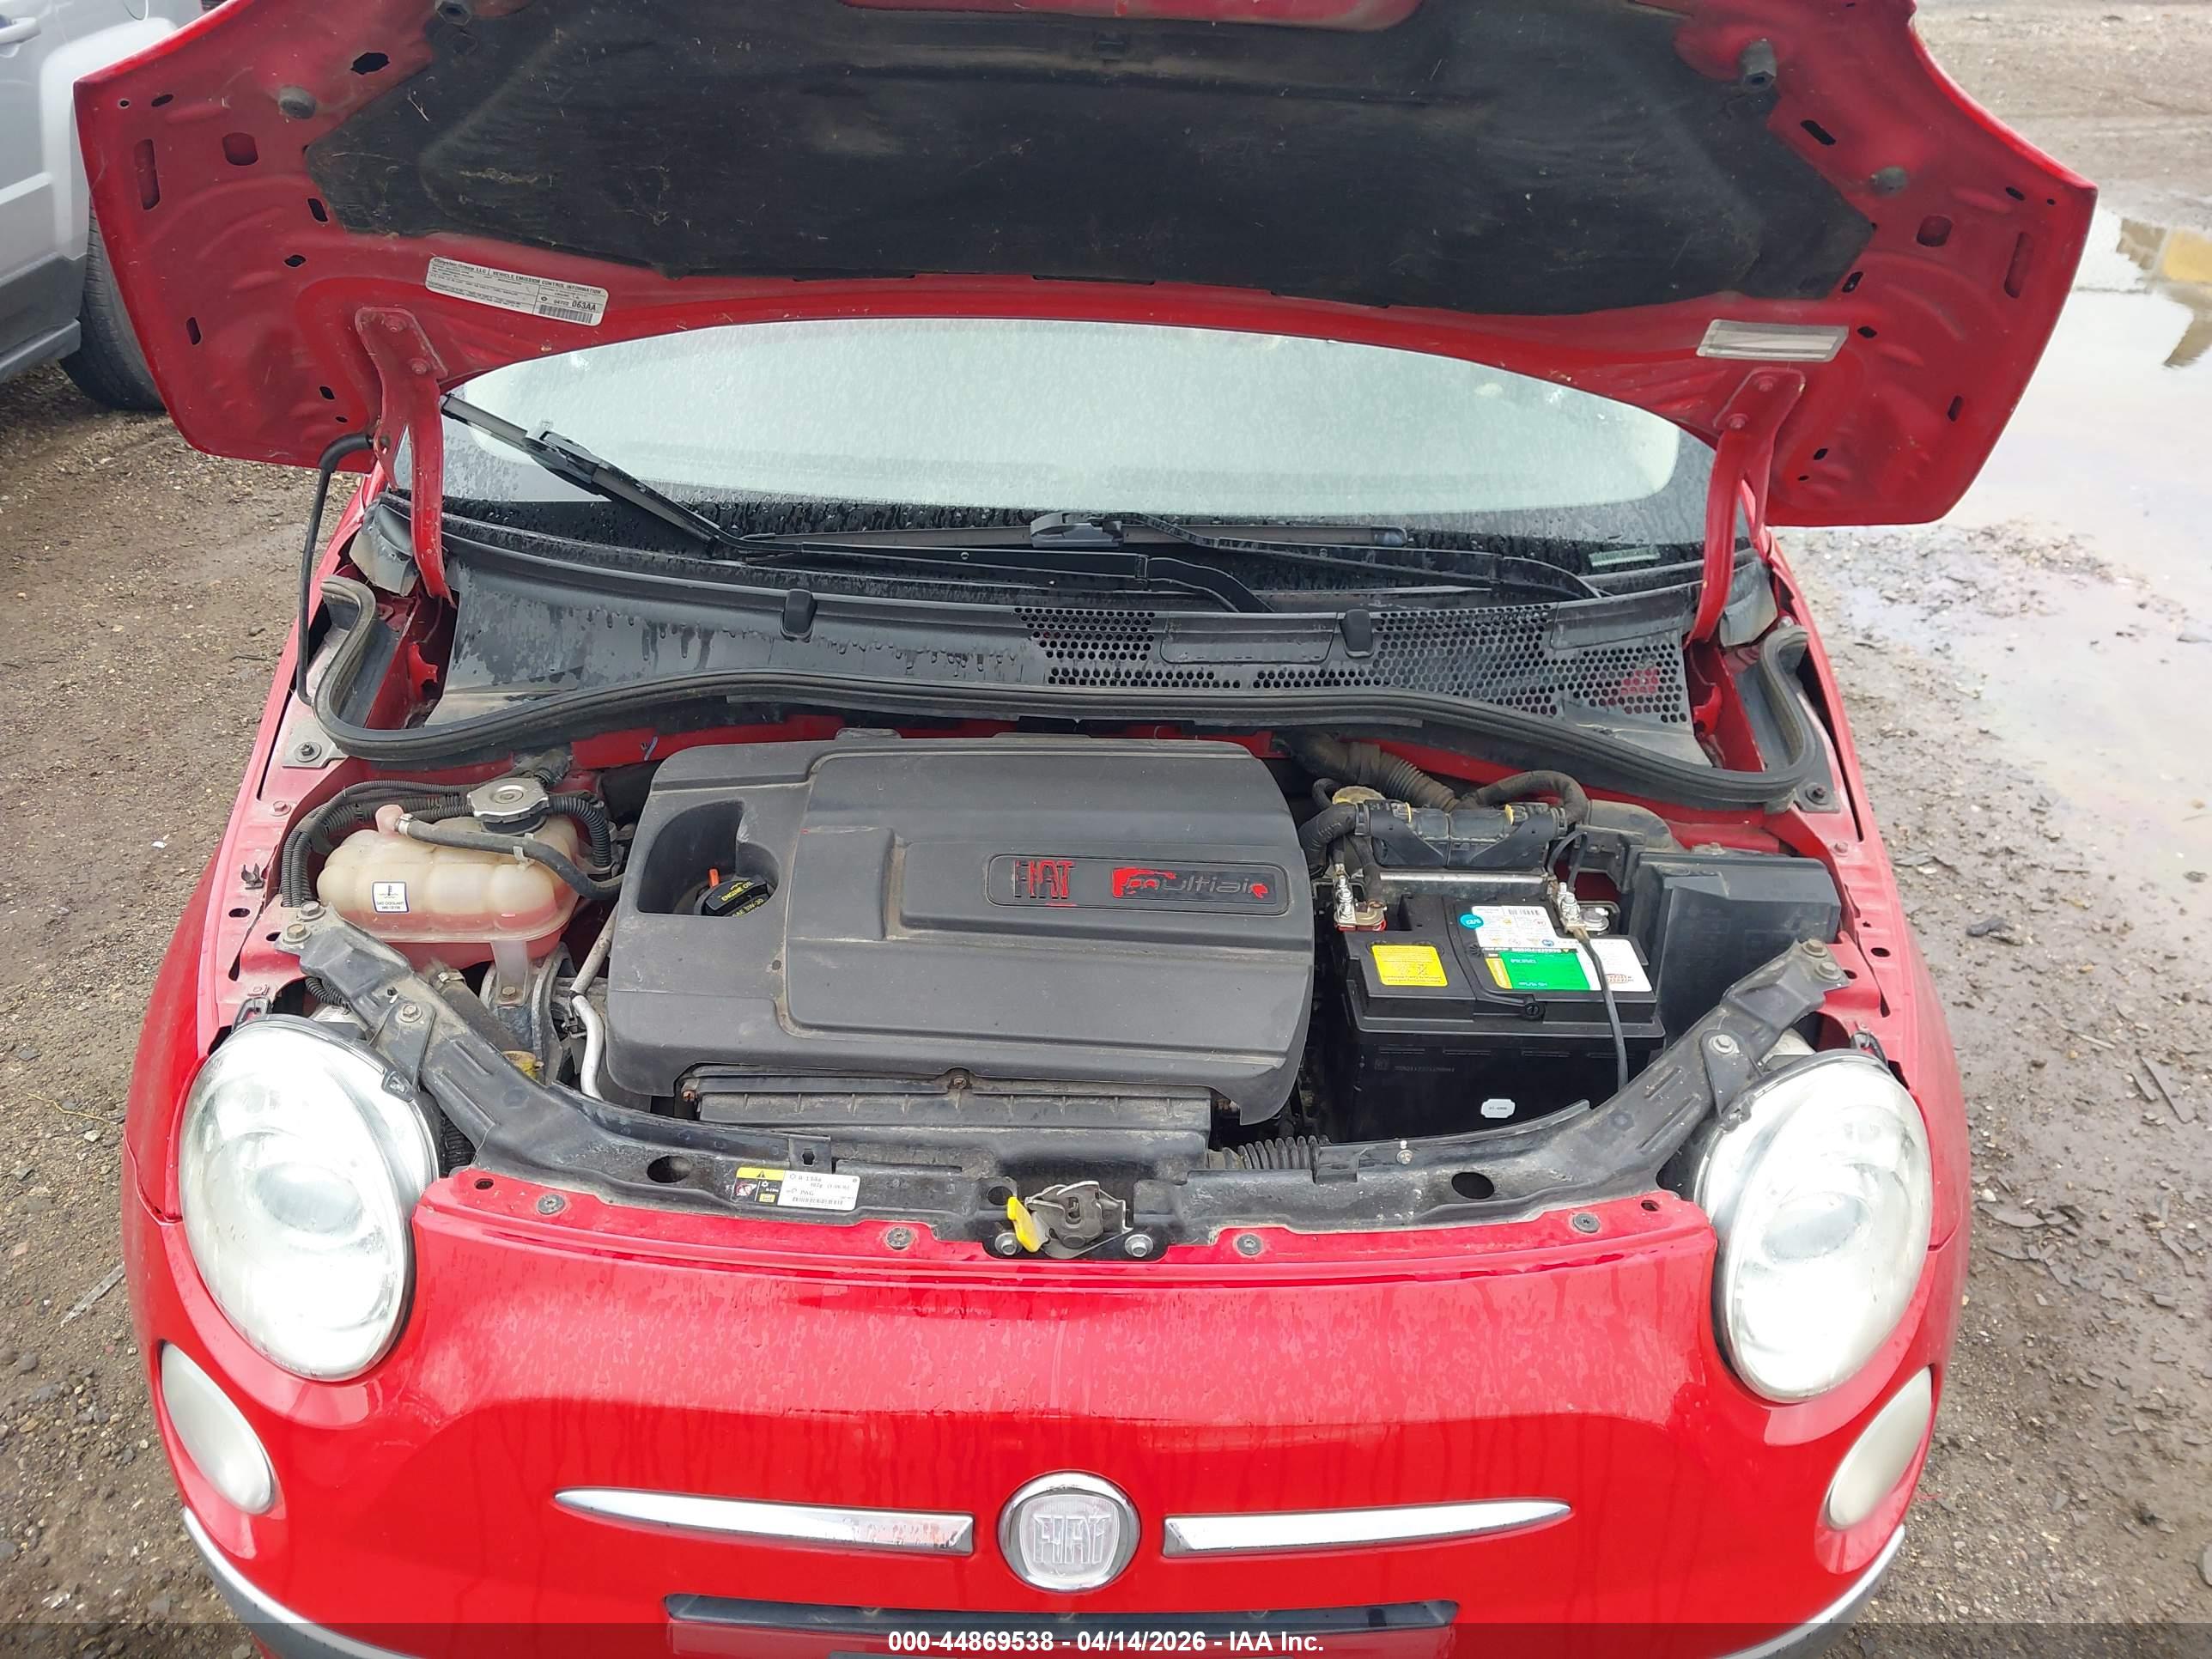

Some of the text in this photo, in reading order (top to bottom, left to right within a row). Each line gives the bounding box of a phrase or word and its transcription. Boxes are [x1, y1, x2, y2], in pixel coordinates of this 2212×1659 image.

[492, 270, 514, 279] VEHICLE
[515, 275, 541, 284] EMISSION
[541, 280, 565, 289] CONTROL
[566, 284, 601, 295] INFORMATION
[571, 300, 597, 311] 063AA
[721, 880, 756, 902] ENGINE OIL
[1014, 860, 1074, 899] FIAT
[1032, 1514, 1113, 1565] FIAT
